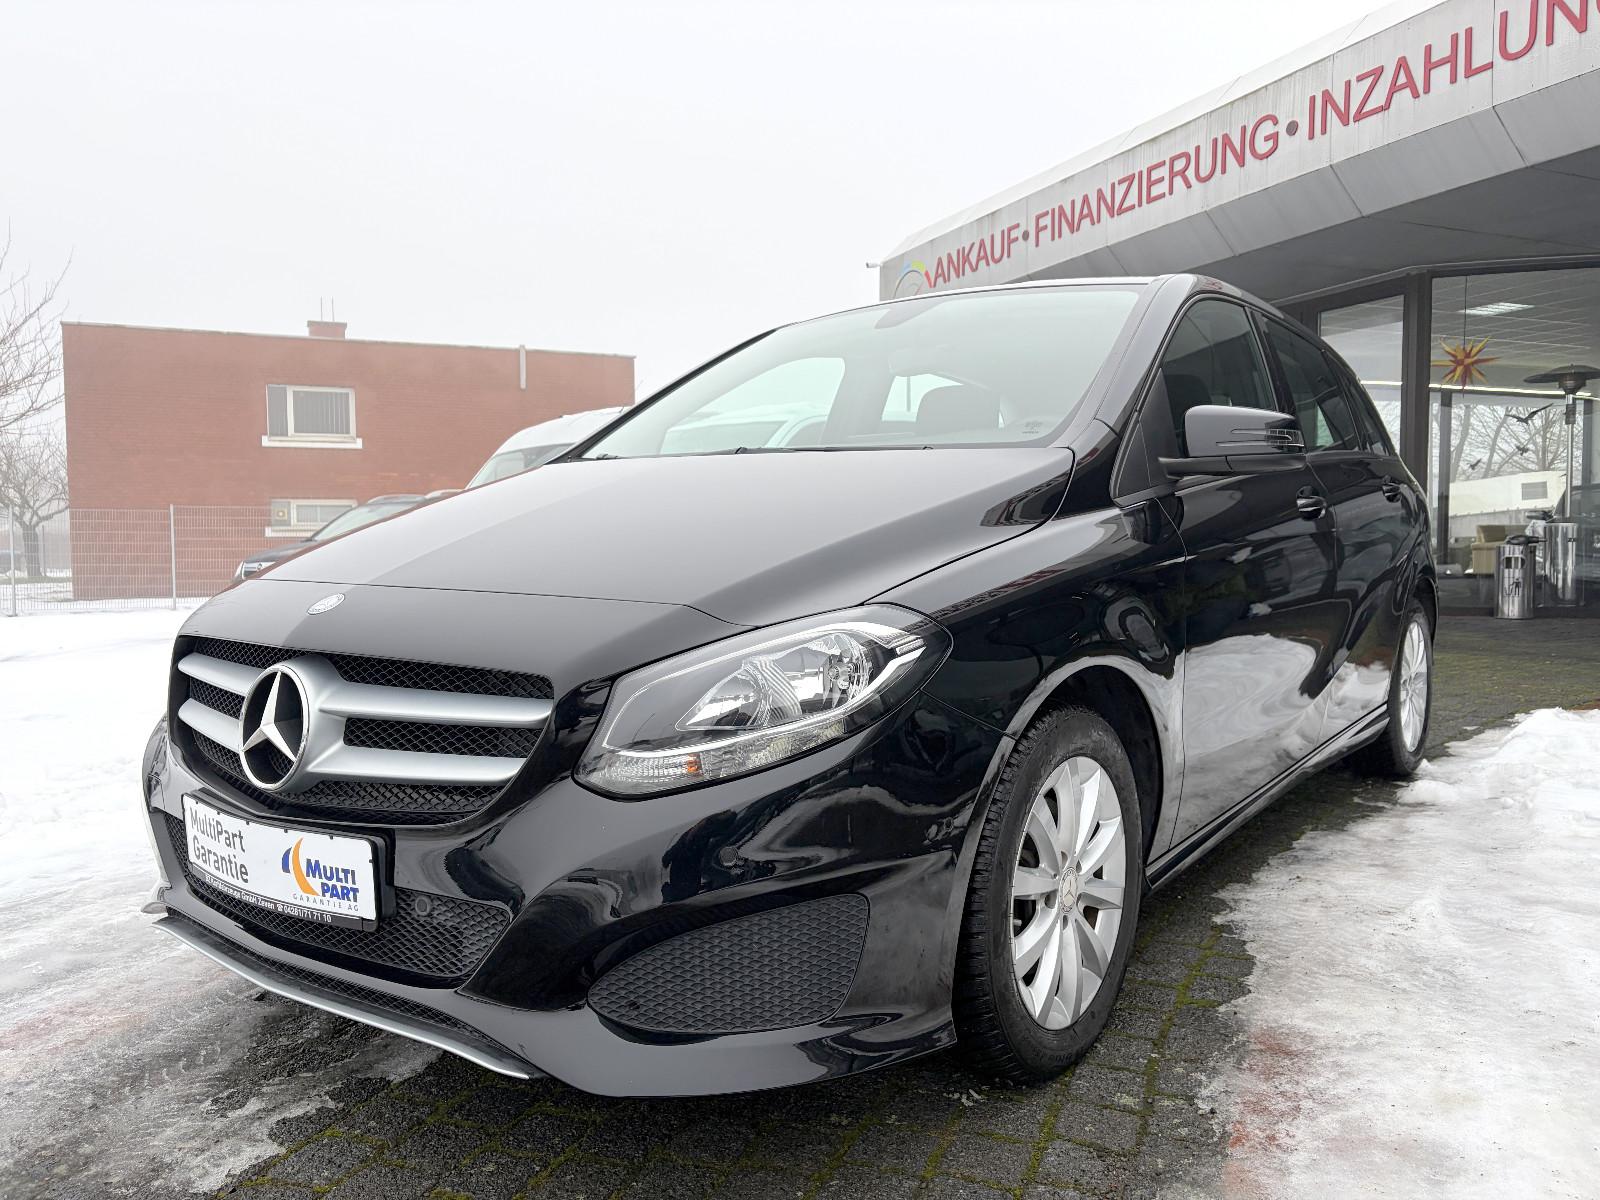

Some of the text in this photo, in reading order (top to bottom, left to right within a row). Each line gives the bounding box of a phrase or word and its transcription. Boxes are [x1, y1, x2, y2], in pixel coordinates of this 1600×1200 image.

[933, 0, 1600, 288] ANKAUF FINANZIERUNG INZAHLUN
[190, 806, 246, 853] MultiPart
[193, 834, 249, 884] Garantie
[305, 858, 356, 885] MULTI
[292, 893, 359, 912] GARANTIE AG
[321, 881, 359, 903] PART
